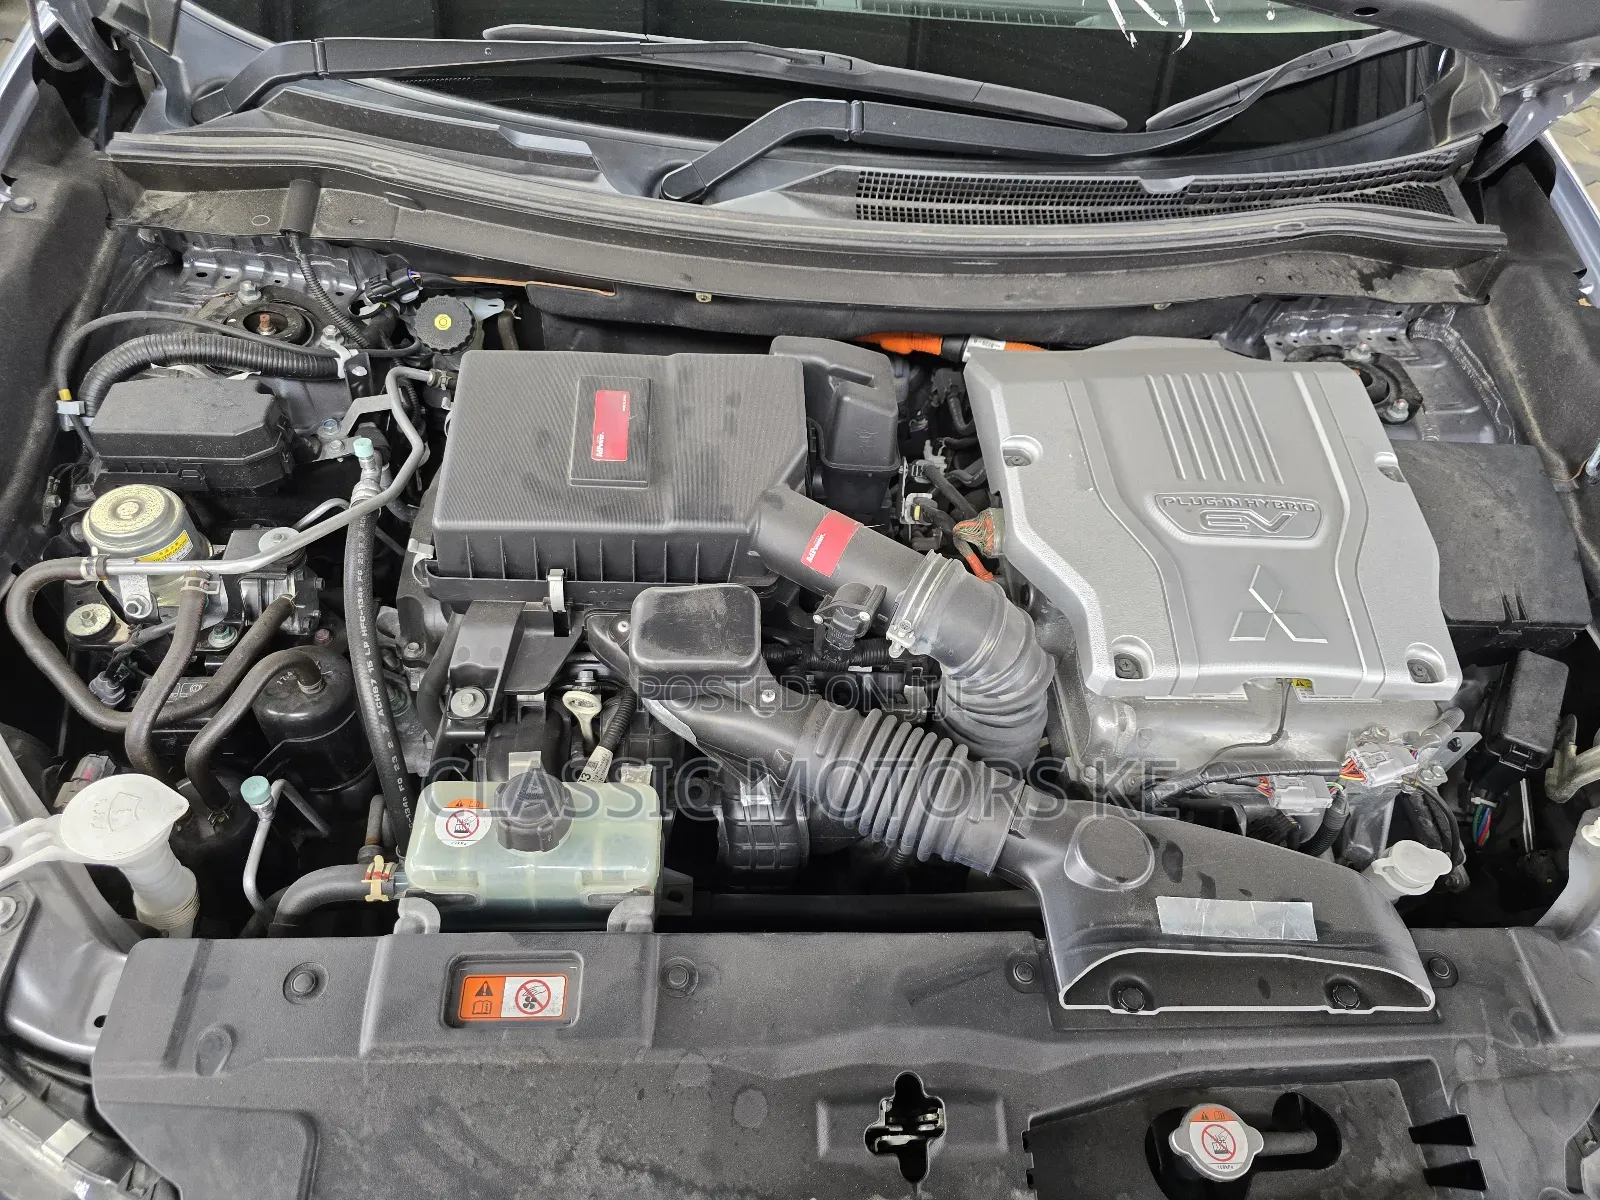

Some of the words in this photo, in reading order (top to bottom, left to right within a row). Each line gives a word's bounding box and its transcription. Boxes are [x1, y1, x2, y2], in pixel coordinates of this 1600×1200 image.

[1162, 496, 1241, 508] PLUG-IN
[1245, 497, 1316, 513] HYBRID
[1199, 508, 1299, 534] EV
[362, 641, 371, 656] LP
[366, 660, 375, 674] 15
